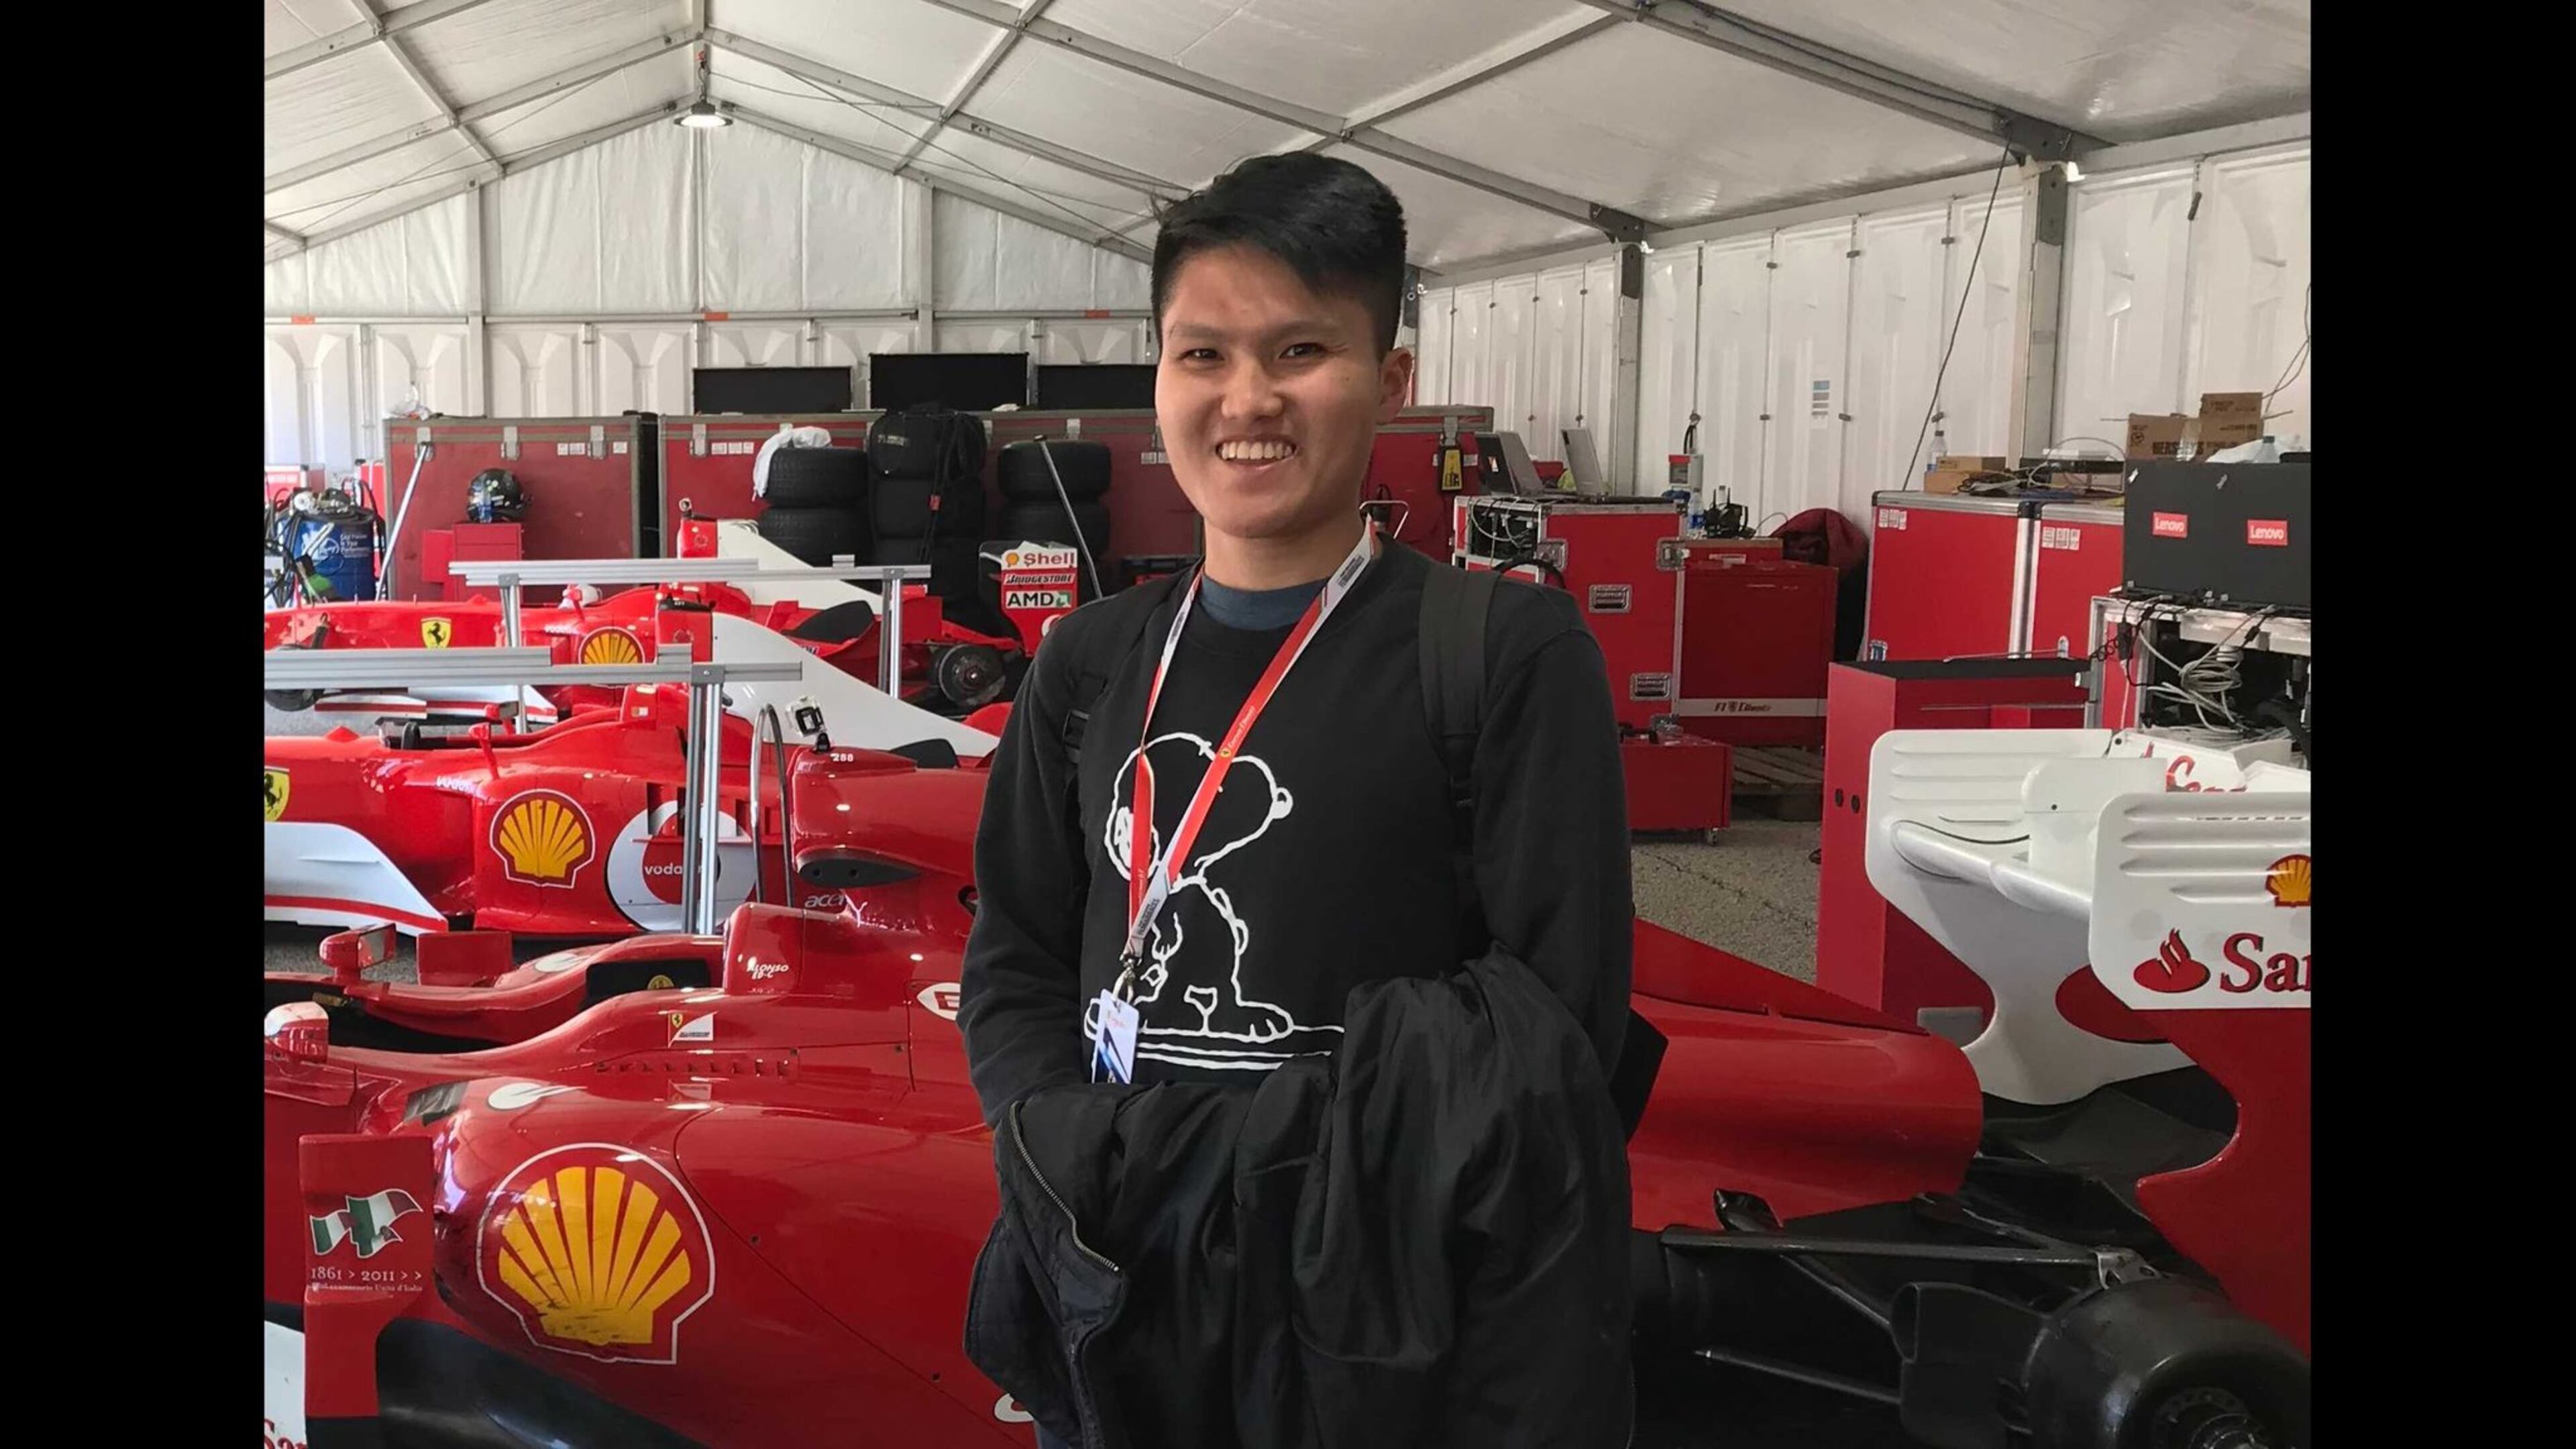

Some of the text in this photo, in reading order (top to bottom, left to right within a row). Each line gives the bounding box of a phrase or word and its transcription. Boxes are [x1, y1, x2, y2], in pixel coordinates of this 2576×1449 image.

[2154, 517, 2185, 532] Lenovo
[2250, 525, 2284, 539] Lenovo
[1023, 552, 1075, 565] Shell
[1007, 592, 1055, 607] AMD
[804, 894, 845, 908] acer
[2219, 932, 2311, 994] Sa
[311, 1266, 394, 1281] 1861 2011
